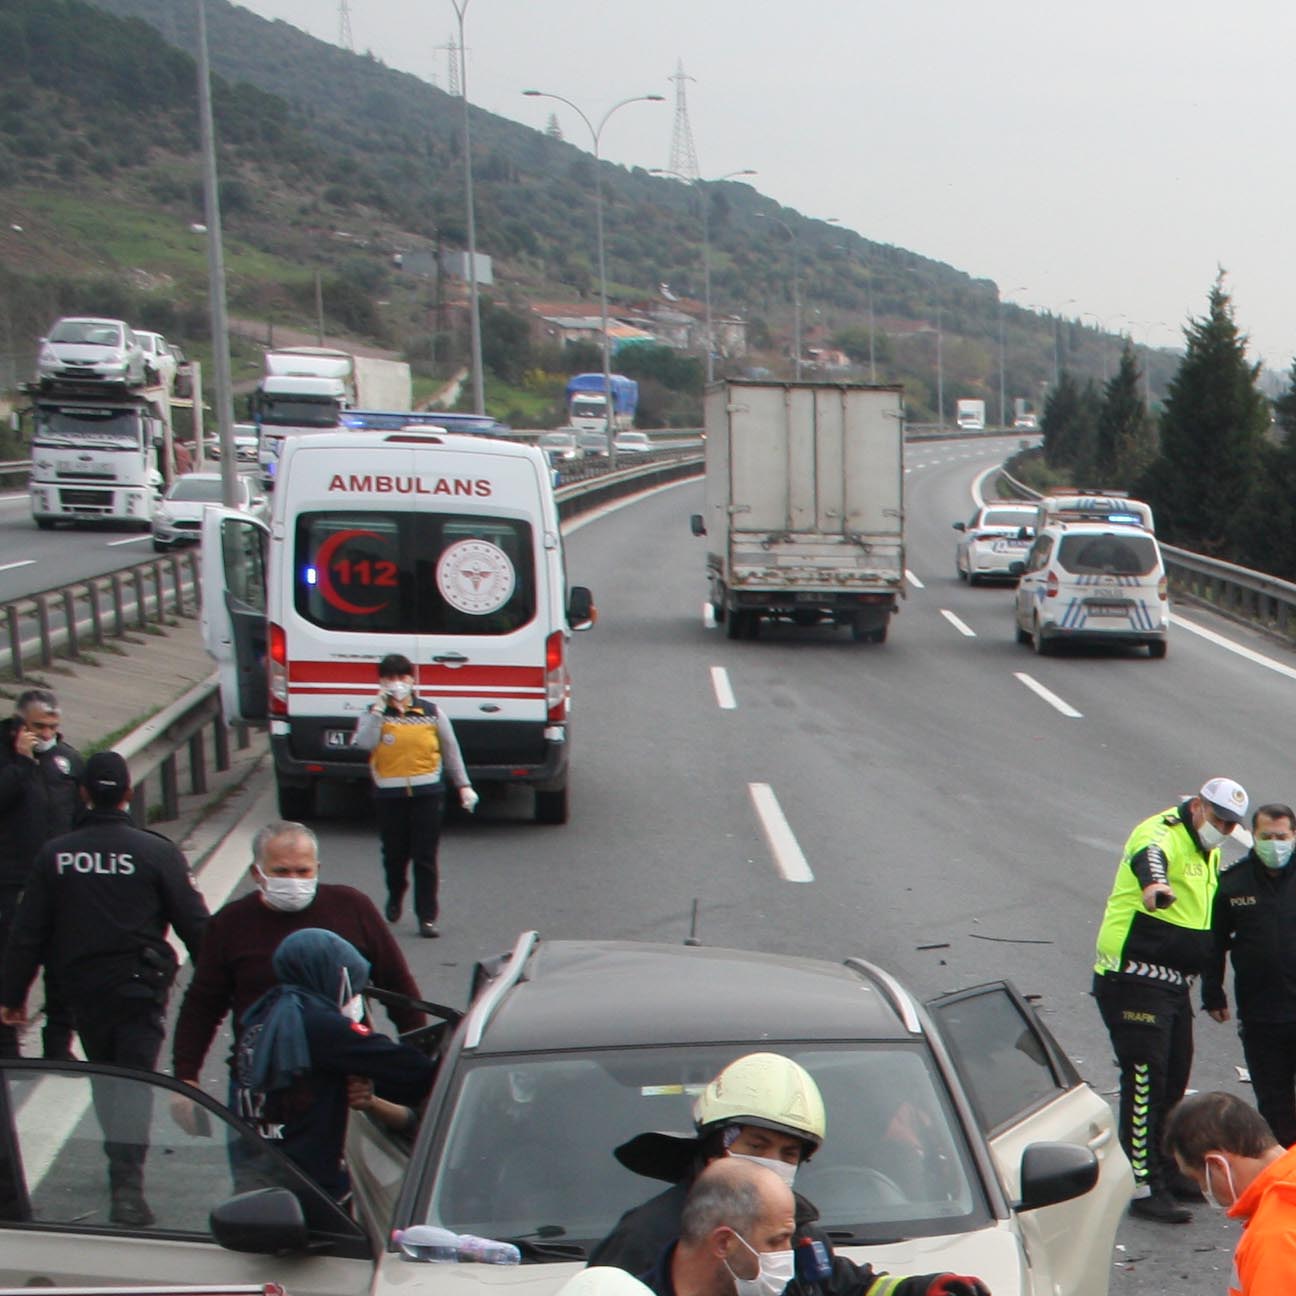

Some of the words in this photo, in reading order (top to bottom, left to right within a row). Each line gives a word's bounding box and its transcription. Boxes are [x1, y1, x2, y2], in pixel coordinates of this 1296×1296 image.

[328, 474, 493, 497] AMBULANS
[333, 560, 398, 587] 112
[329, 731, 345, 745] 41
